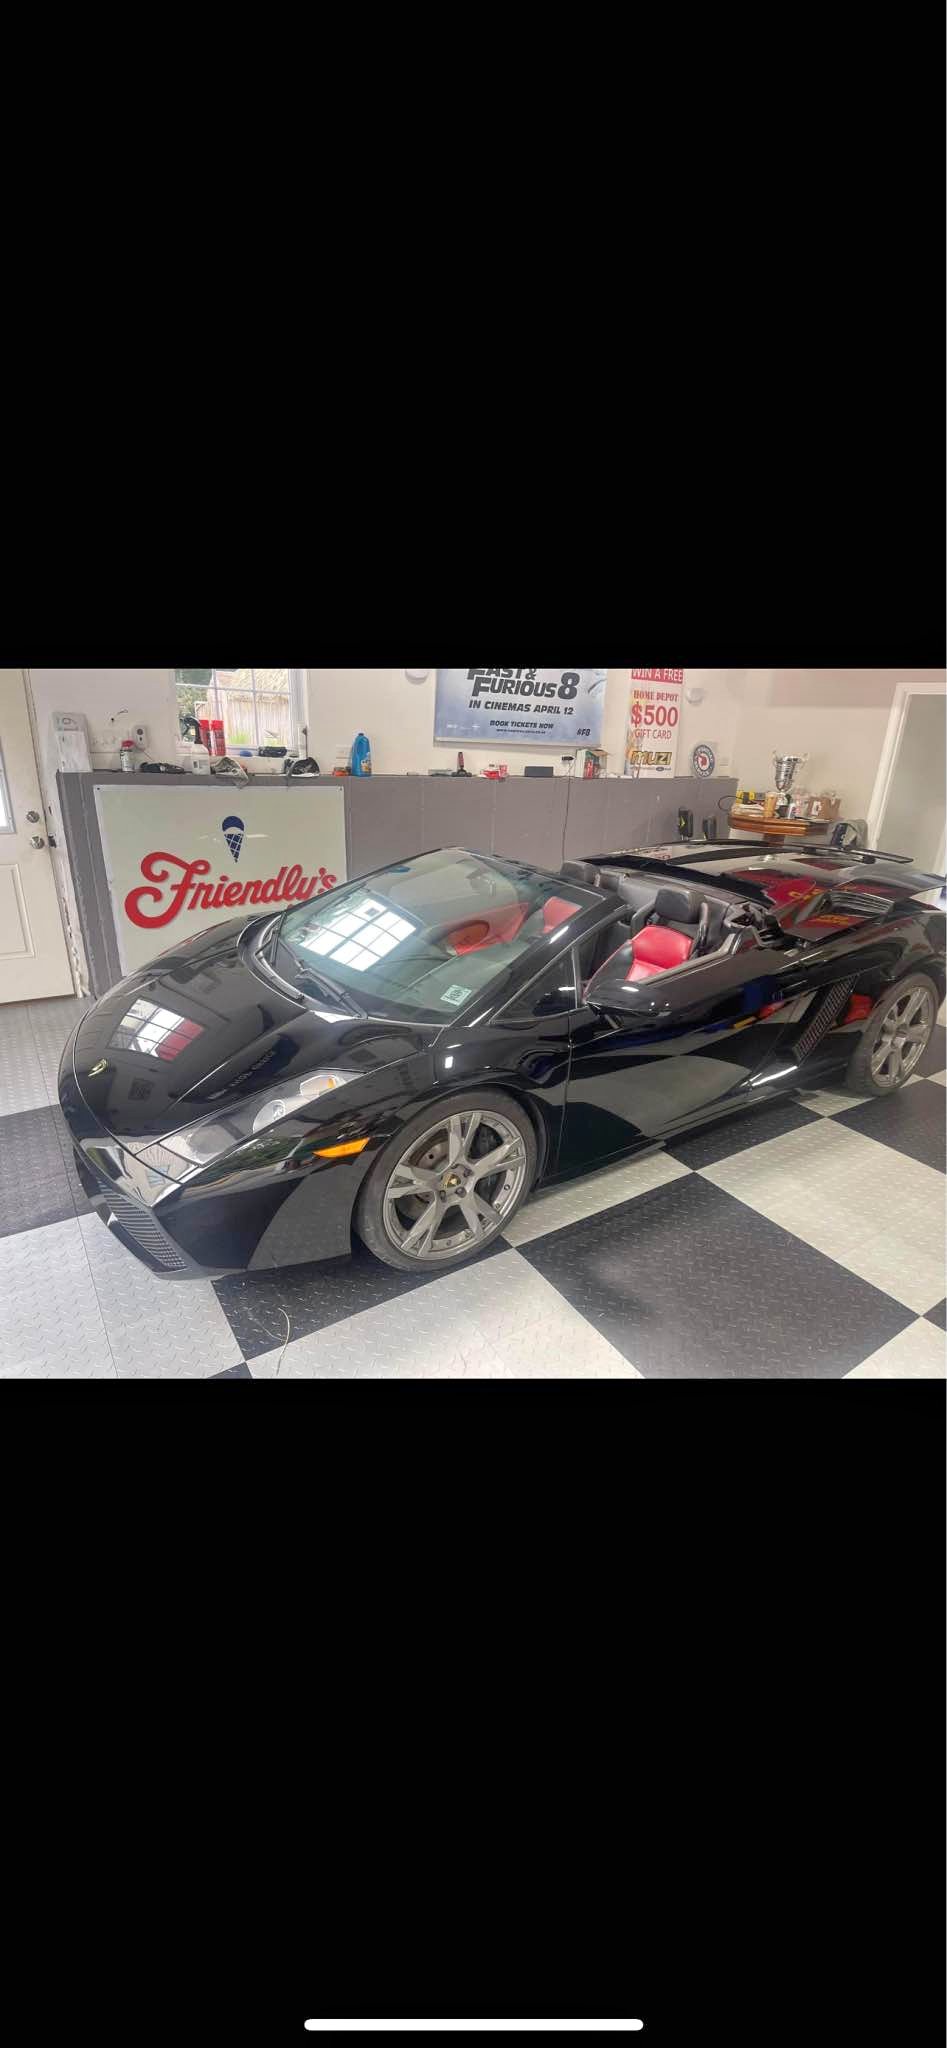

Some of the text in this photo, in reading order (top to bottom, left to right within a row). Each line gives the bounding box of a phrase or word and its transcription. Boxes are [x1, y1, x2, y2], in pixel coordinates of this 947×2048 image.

[467, 668, 522, 680] FAST
[632, 668, 683, 681] WIN A FREE
[471, 672, 580, 700] FURIOUS 8
[633, 690, 679, 702] HOME DEPOT
[469, 700, 574, 715] IN CINEMAS APRIL 12
[631, 701, 679, 728] $500
[634, 729, 672, 740] GIFT CARD
[124, 851, 337, 929] Friendly's
